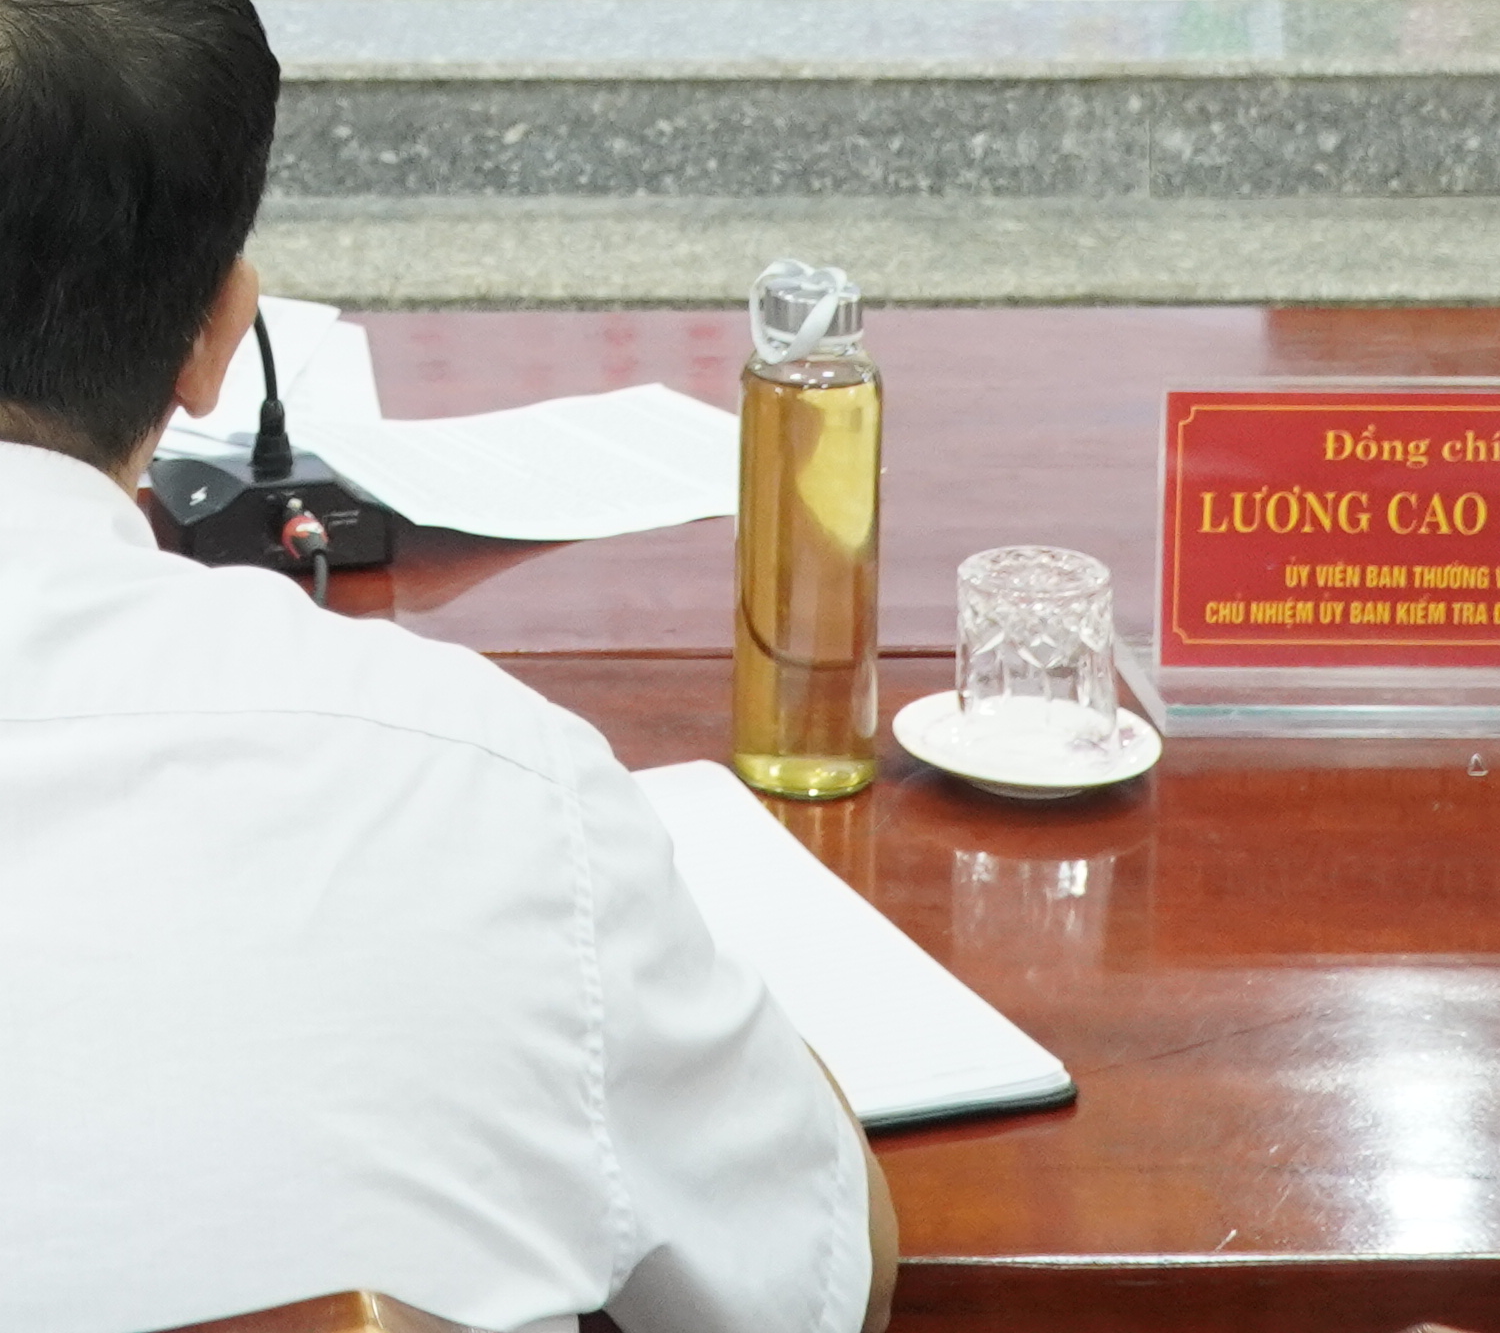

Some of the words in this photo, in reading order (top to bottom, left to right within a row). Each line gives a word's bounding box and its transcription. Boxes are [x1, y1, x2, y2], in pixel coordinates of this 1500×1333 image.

[1322, 423, 1429, 468] Đồng
[1198, 484, 1372, 535] LƯƠNG
[1386, 491, 1490, 535] CAO
[1366, 564, 1404, 588] BAN
[1350, 602, 1392, 625] BAN
[1452, 602, 1489, 625] TRA
